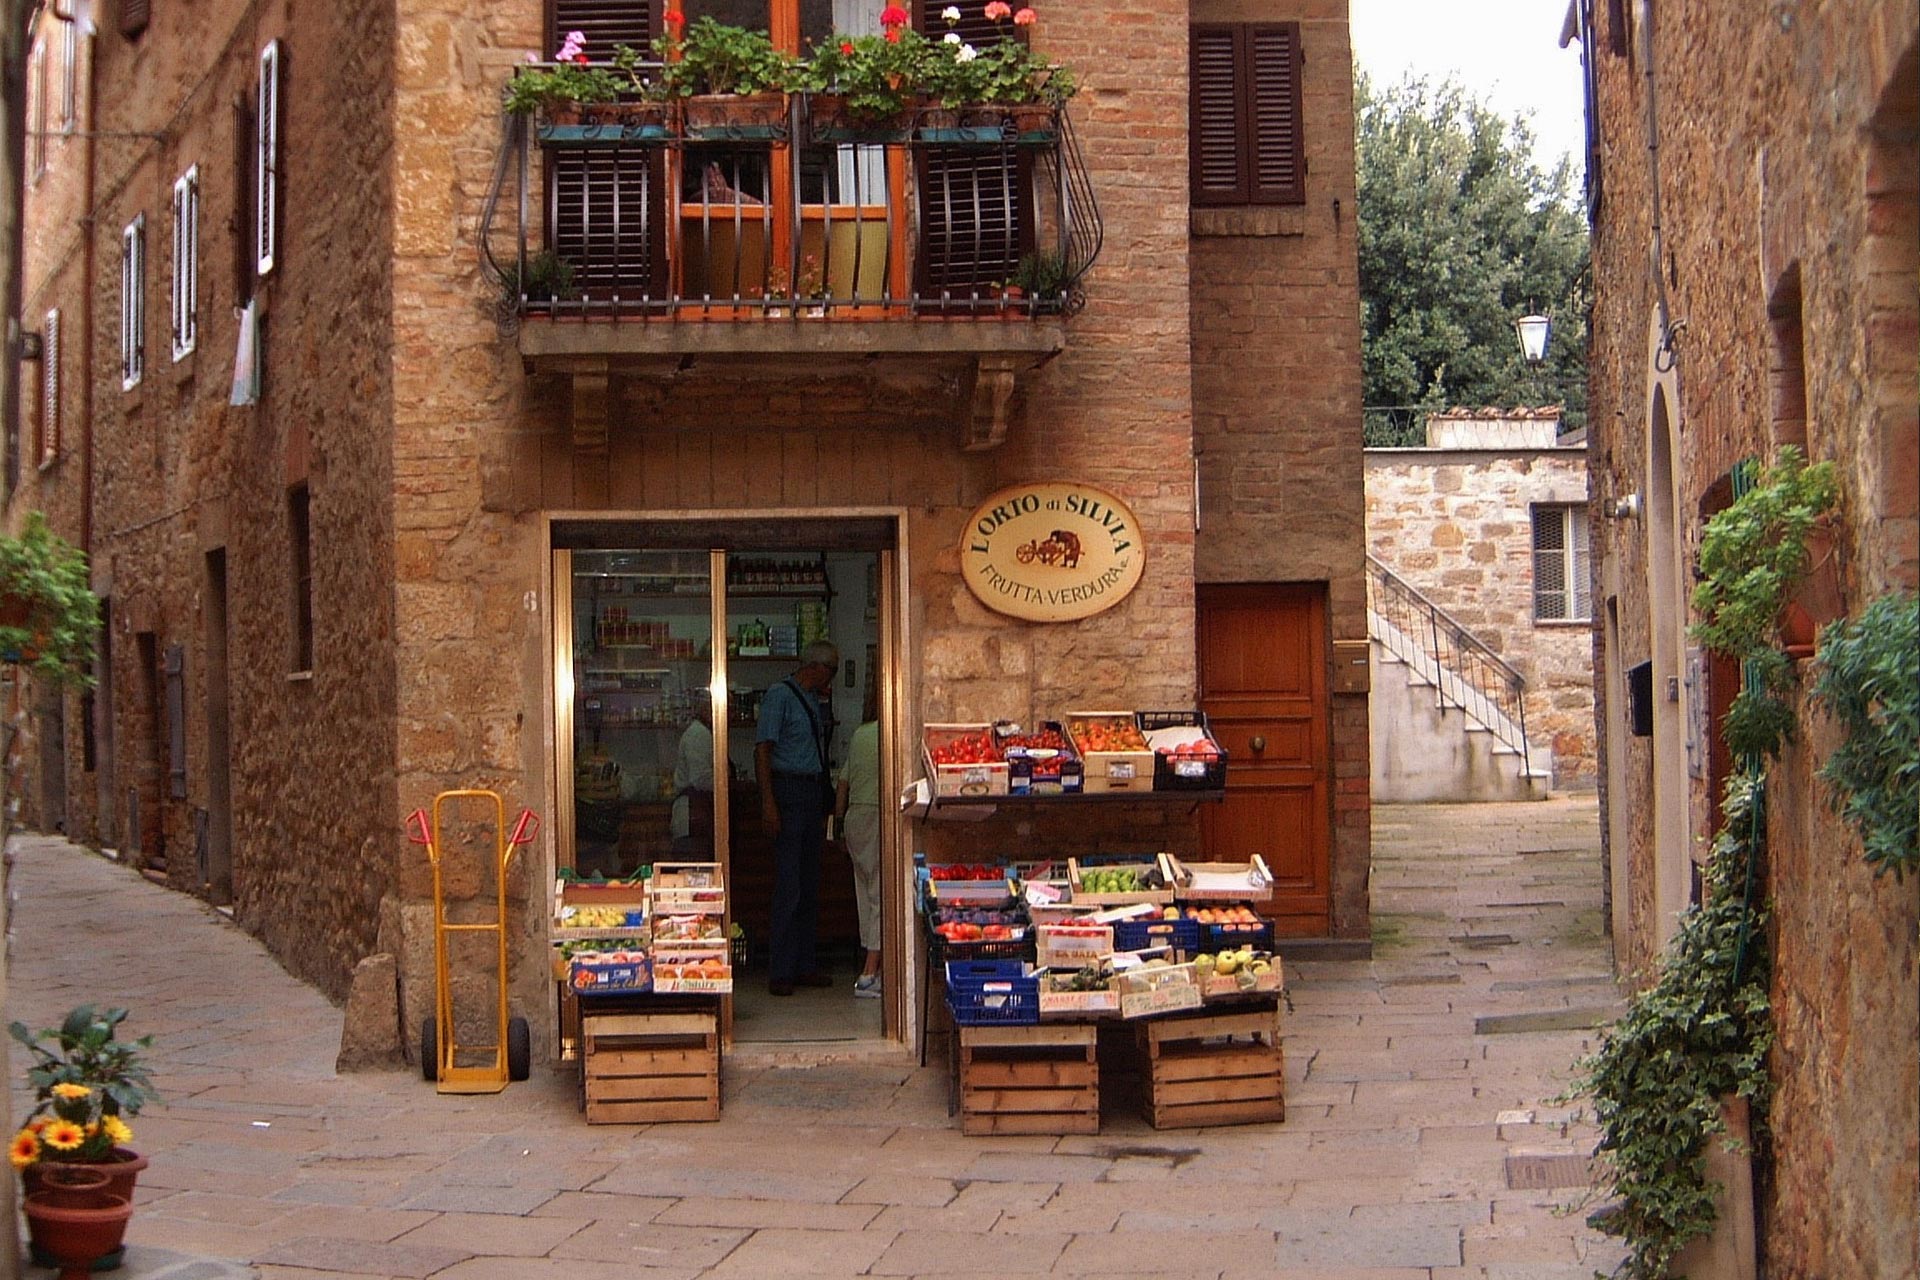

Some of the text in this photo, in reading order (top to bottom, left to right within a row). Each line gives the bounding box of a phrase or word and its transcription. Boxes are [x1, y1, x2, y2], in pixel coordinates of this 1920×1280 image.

[1046, 499, 1060, 511] di
[1065, 493, 1131, 555] SILVIA
[980, 563, 1125, 605] FRUTTA VERDURA
